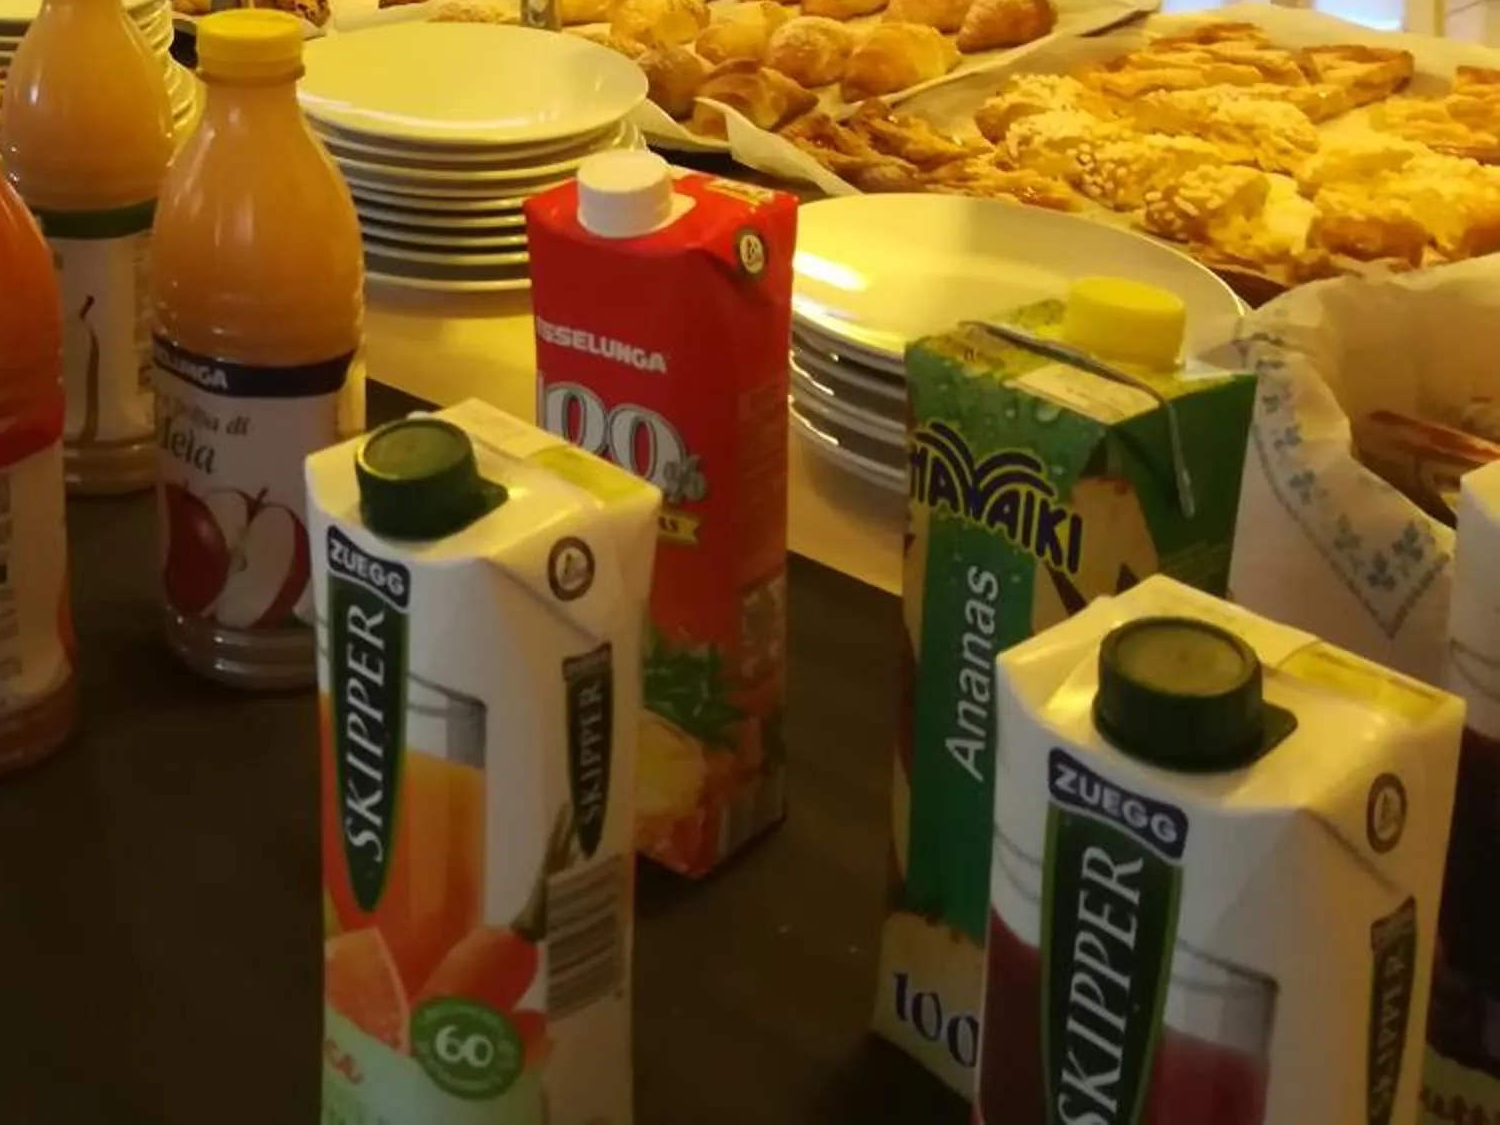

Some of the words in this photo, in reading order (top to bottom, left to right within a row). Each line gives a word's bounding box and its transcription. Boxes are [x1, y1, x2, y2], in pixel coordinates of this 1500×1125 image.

[329, 538, 405, 597] ZUEGG
[345, 604, 386, 863] SKIPPER
[945, 565, 999, 783] Ananas
[578, 679, 603, 825] SKIPPER
[1055, 761, 1178, 844] ZUEGG
[435, 1025, 494, 1068] 60
[1057, 845, 1145, 1125] SKIPPER
